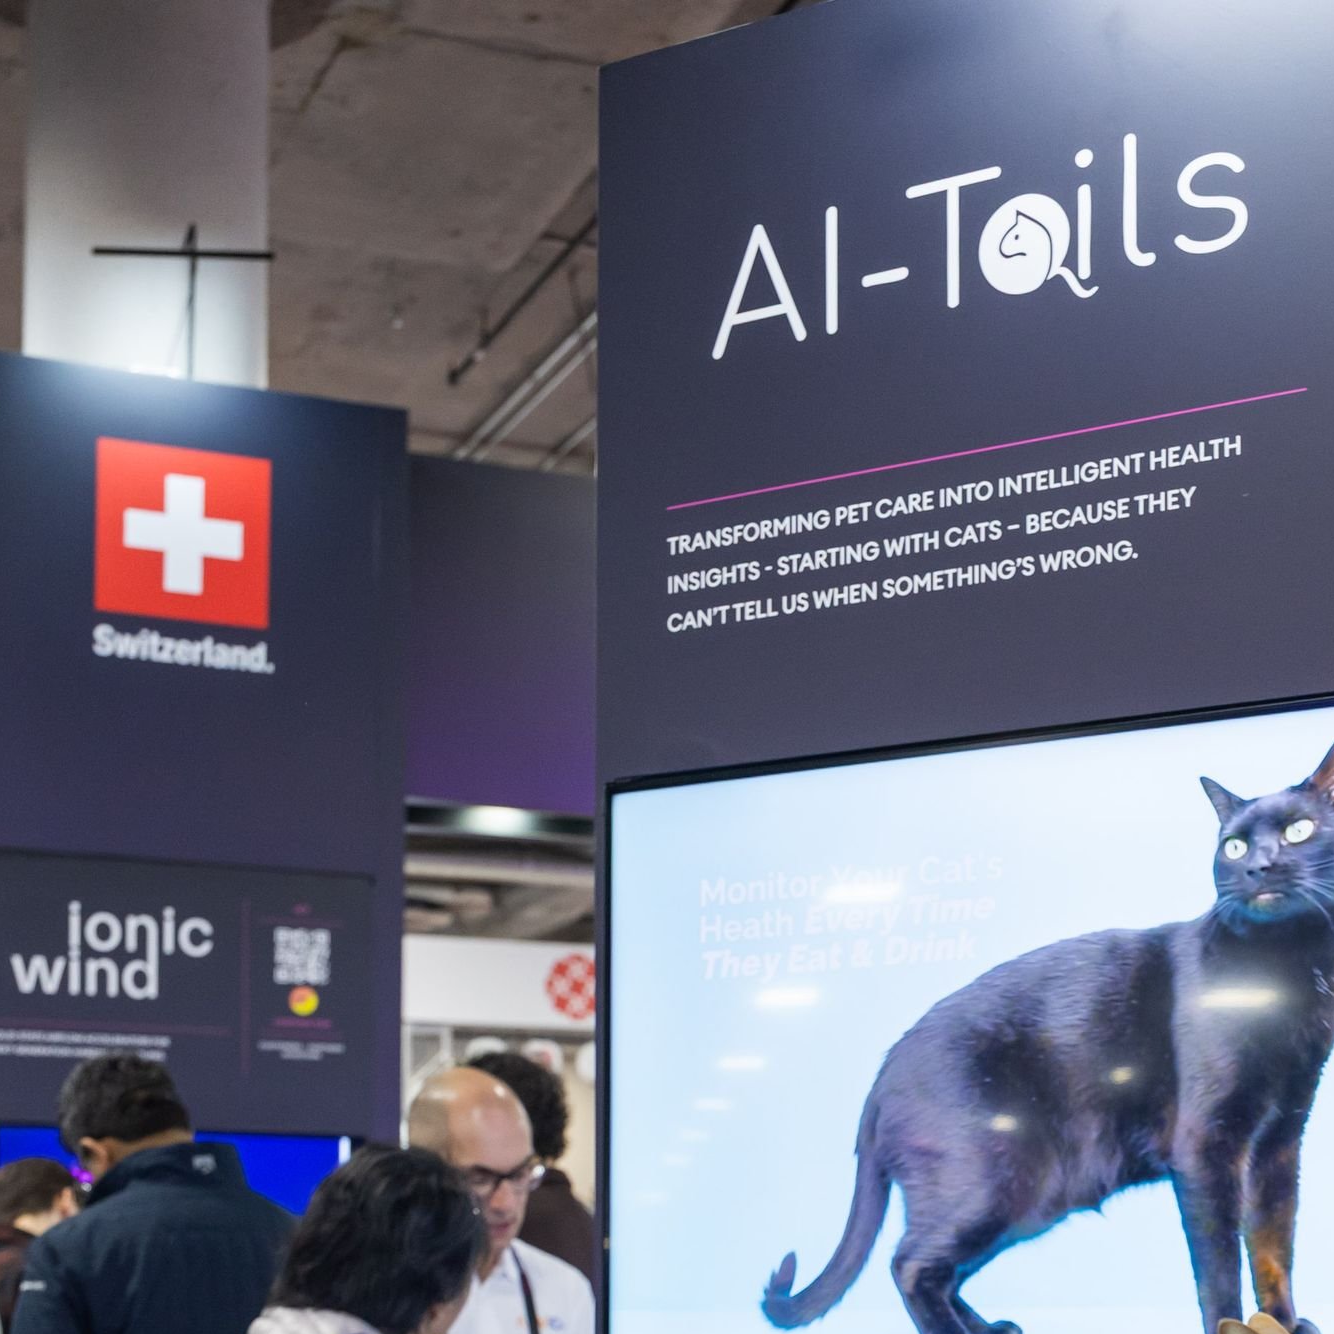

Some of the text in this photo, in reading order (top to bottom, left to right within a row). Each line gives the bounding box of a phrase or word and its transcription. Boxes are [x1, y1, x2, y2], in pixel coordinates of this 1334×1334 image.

[666, 434, 1242, 556] TRANSFORMING PET CARE INTO INTELLIGENT HEALTH
[666, 560, 761, 595] INSIGHTS
[776, 541, 880, 577] STARTING
[883, 530, 940, 558] WITH
[943, 519, 1003, 548] CATS
[1025, 497, 1131, 536] BECAUSE
[1133, 485, 1198, 516] THEY
[731, 598, 779, 623] TELL
[781, 592, 809, 615] US
[812, 580, 878, 610] WHEN
[1038, 539, 1139, 574] WRONG.
[92, 622, 275, 674] Switzerland.
[699, 870, 824, 907] Monitor
[803, 902, 903, 938] Every
[906, 894, 997, 927] Time
[68, 900, 214, 958] ionic
[700, 927, 979, 984] They Eat & Drink
[9, 948, 160, 1000] wind
